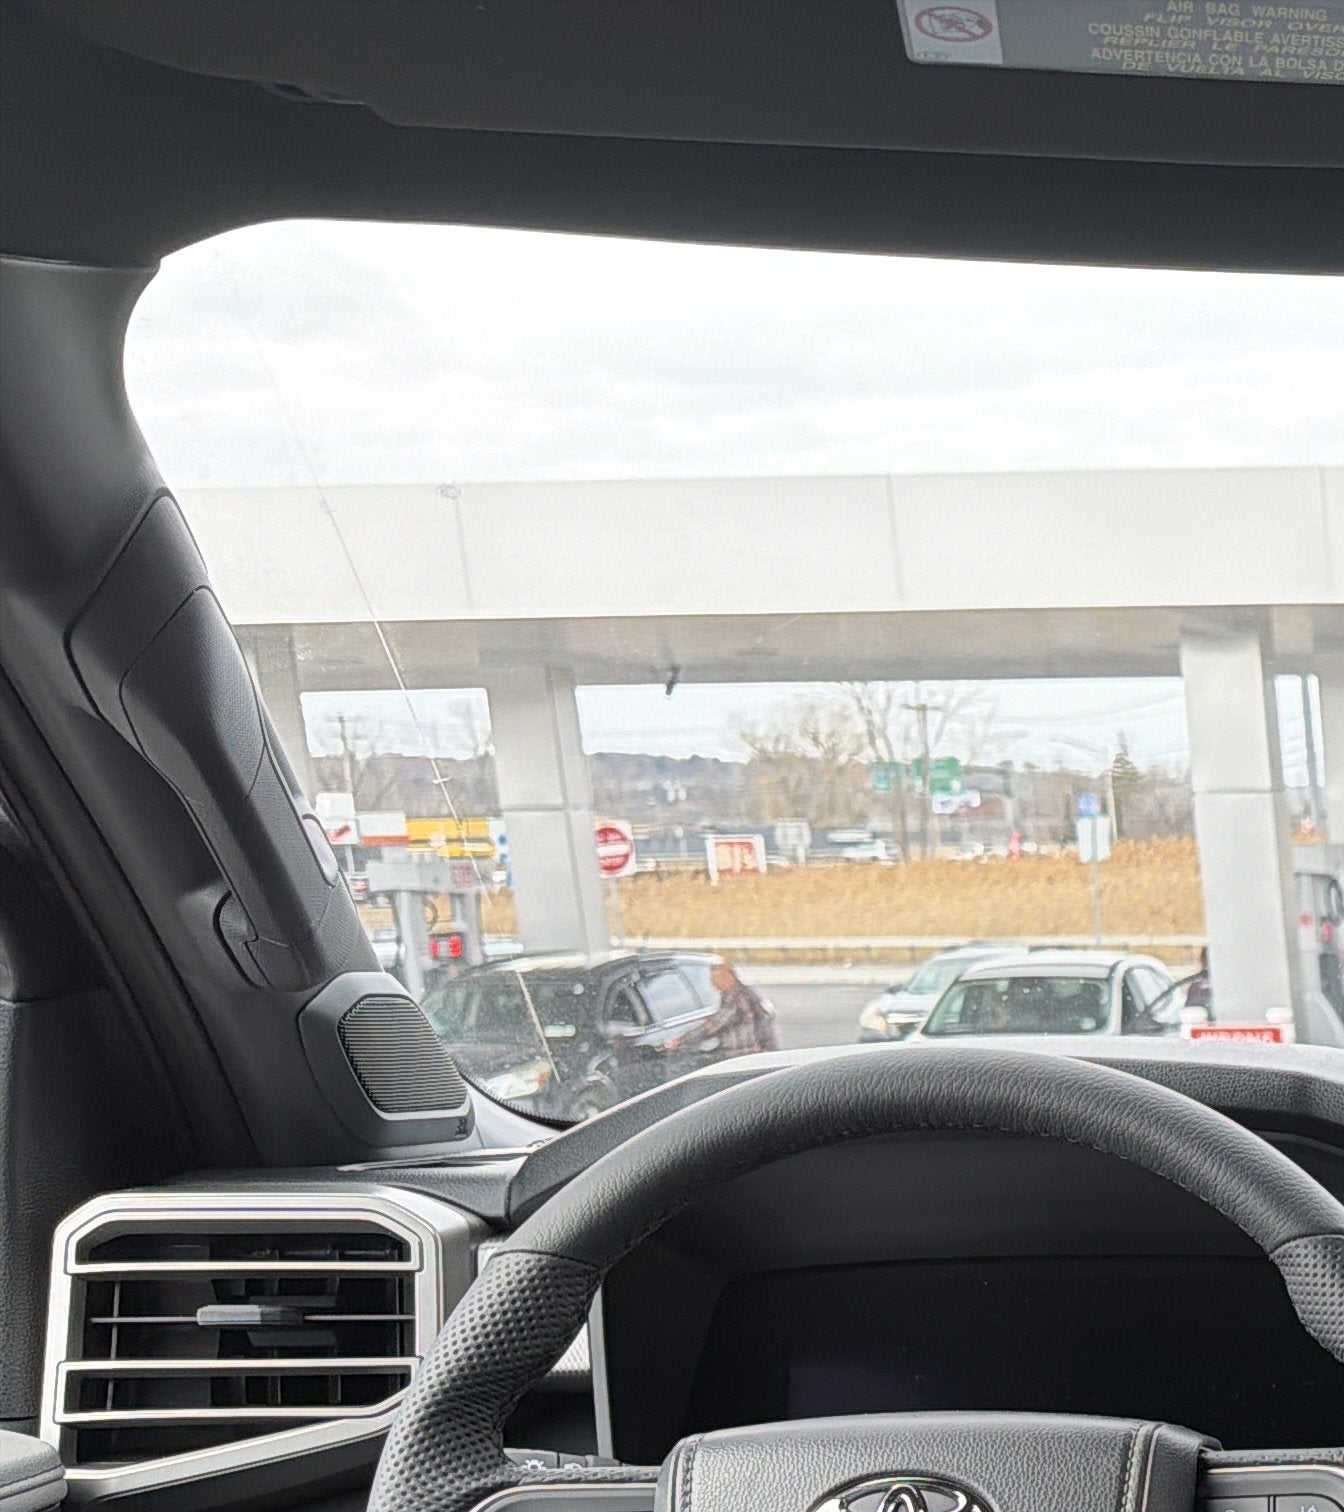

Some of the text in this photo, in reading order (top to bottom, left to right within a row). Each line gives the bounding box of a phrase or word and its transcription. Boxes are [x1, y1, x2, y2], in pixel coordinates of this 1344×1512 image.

[1166, 0, 1328, 22] AIR BAG WARNING
[1144, 13, 1191, 24] FLIP
[1206, 17, 1272, 30] VISOR
[1088, 22, 1161, 38] COUSSIN
[1168, 26, 1264, 44] GONFLABLE
[1103, 36, 1196, 50] REPLIER
[1212, 41, 1238, 52] LE
[1090, 47, 1203, 65] ADVERTENCIA
[1209, 53, 1242, 67] CON
[1249, 56, 1268, 68] LA
[1275, 57, 1328, 71] BOLSA
[1121, 60, 1151, 71] DE
[1167, 63, 1245, 77] VUELTA
[1261, 68, 1286, 79] AL
